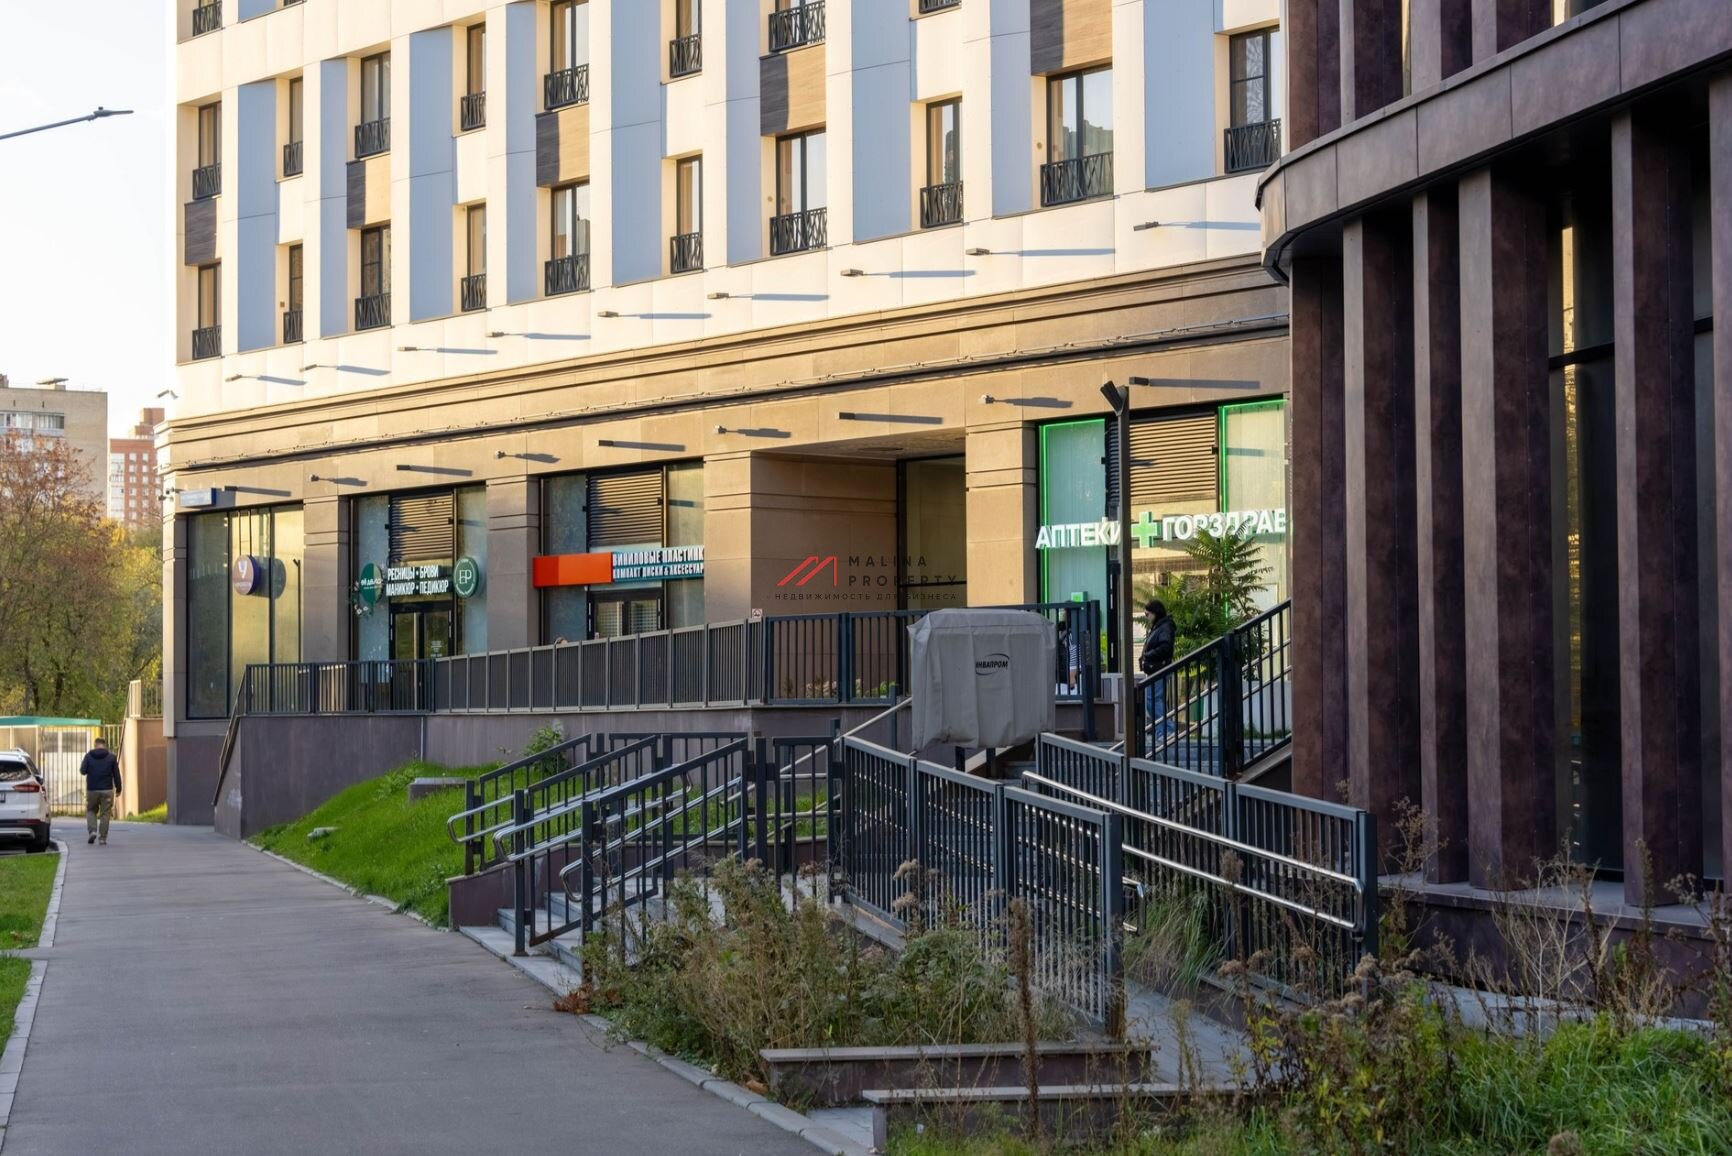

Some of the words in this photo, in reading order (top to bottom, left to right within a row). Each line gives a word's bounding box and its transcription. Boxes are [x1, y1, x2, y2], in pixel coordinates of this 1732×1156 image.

[1162, 508, 1286, 542] ГОРЗДРАВ
[612, 551, 661, 567] ВИНИЛОВЫЕ
[387, 567, 416, 581] РЕСНИЦЫ
[419, 565, 439, 579] БРОВИ
[386, 582, 415, 597] МАНИКЮР
[419, 580, 449, 595] ПЕДИКЮР
